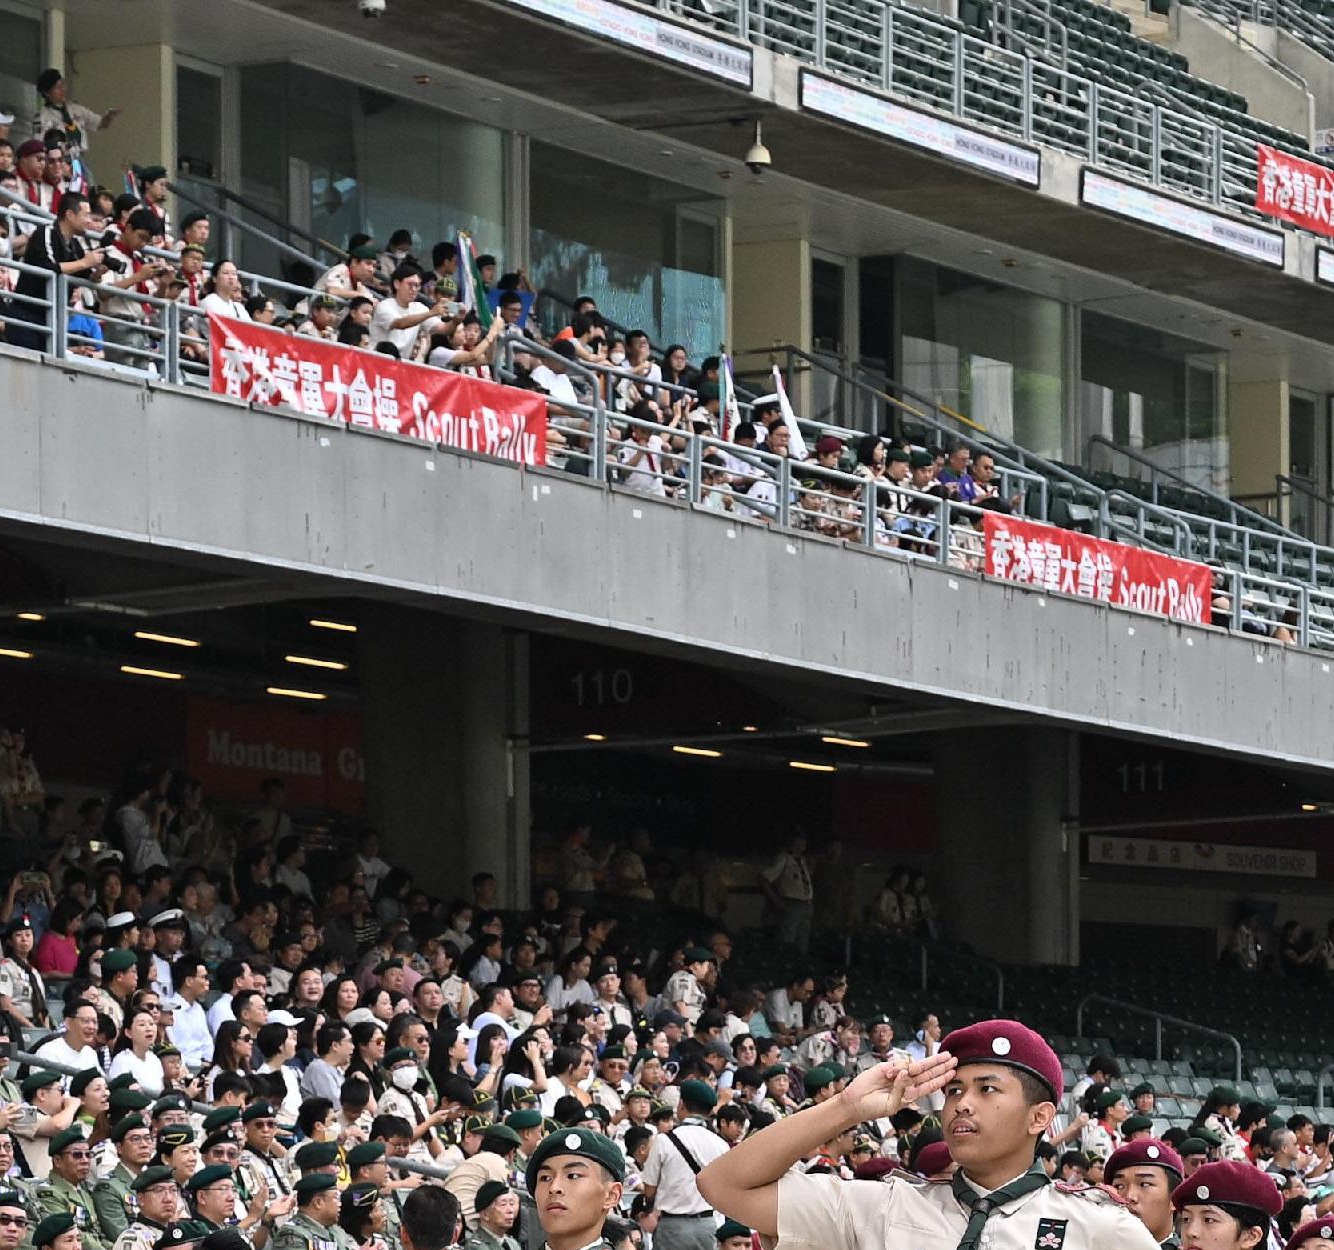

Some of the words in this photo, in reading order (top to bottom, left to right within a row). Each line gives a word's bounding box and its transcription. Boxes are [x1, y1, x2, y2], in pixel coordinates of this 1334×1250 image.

[409, 391, 480, 452] Scout
[481, 406, 538, 465] Rally
[1118, 565, 1167, 615] Scout
[571, 668, 633, 706] 110
[206, 728, 323, 777] Montana
[1117, 760, 1164, 792] 111
